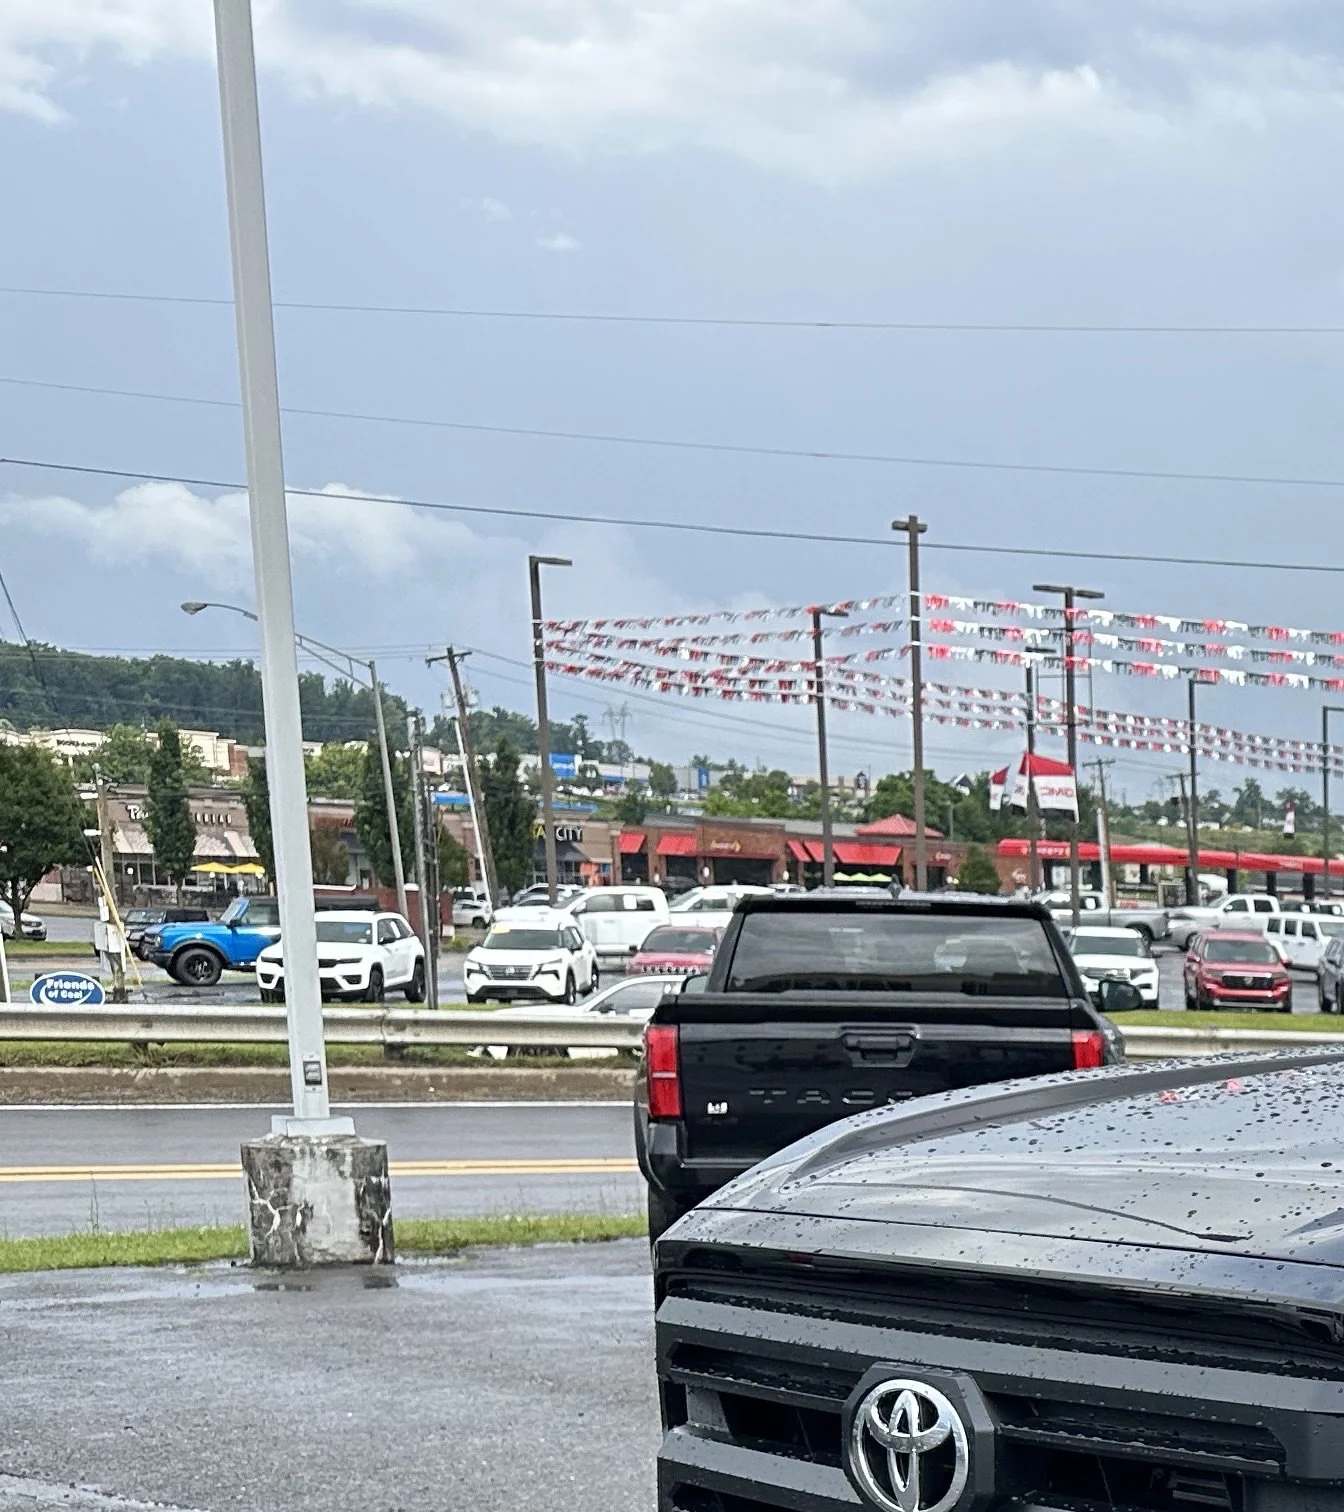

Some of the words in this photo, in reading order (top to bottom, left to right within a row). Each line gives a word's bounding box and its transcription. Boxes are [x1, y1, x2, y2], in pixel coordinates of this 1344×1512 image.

[555, 826, 583, 842] CITY
[46, 979, 95, 991] Friends
[47, 990, 59, 998] of
[60, 990, 83, 999] Coal
